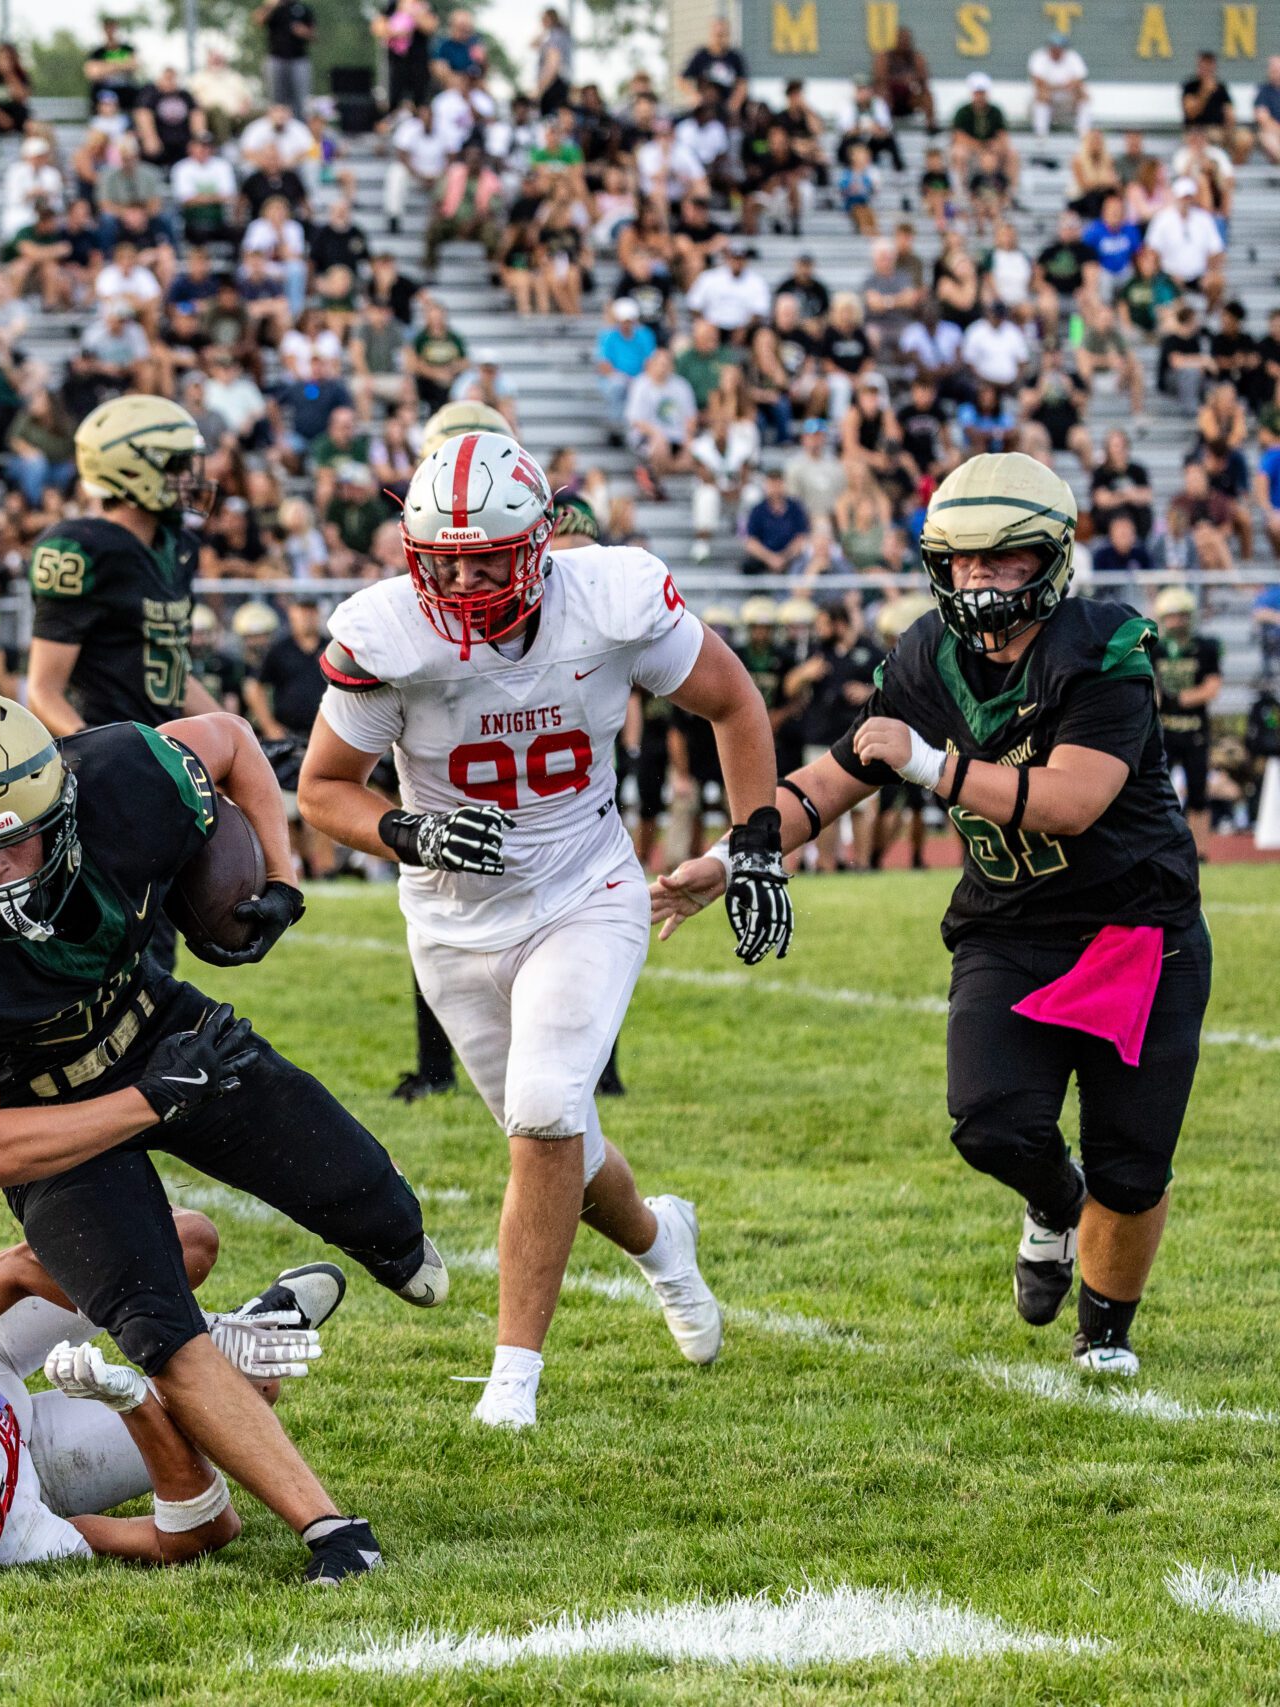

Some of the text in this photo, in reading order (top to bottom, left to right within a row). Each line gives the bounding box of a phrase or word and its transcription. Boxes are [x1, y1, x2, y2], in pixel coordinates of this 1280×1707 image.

[441, 531, 481, 541] Riddell
[33, 546, 86, 596] 52
[480, 705, 563, 736] KNIGHTS
